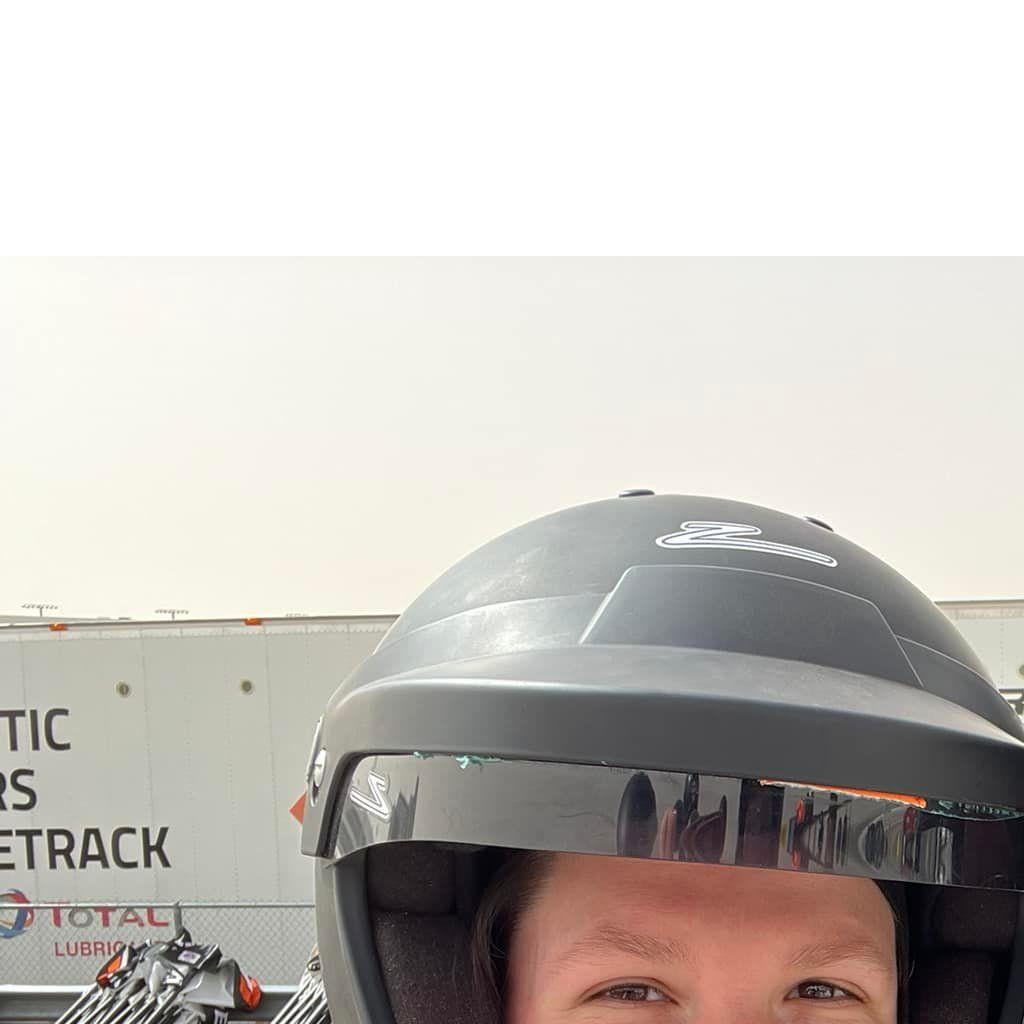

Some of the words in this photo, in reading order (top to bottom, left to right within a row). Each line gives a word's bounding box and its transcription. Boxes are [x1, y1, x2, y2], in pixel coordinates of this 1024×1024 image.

[0, 708, 72, 751] TIC
[44, 901, 170, 928] TOTAL
[55, 940, 138, 957] LUBRIC
